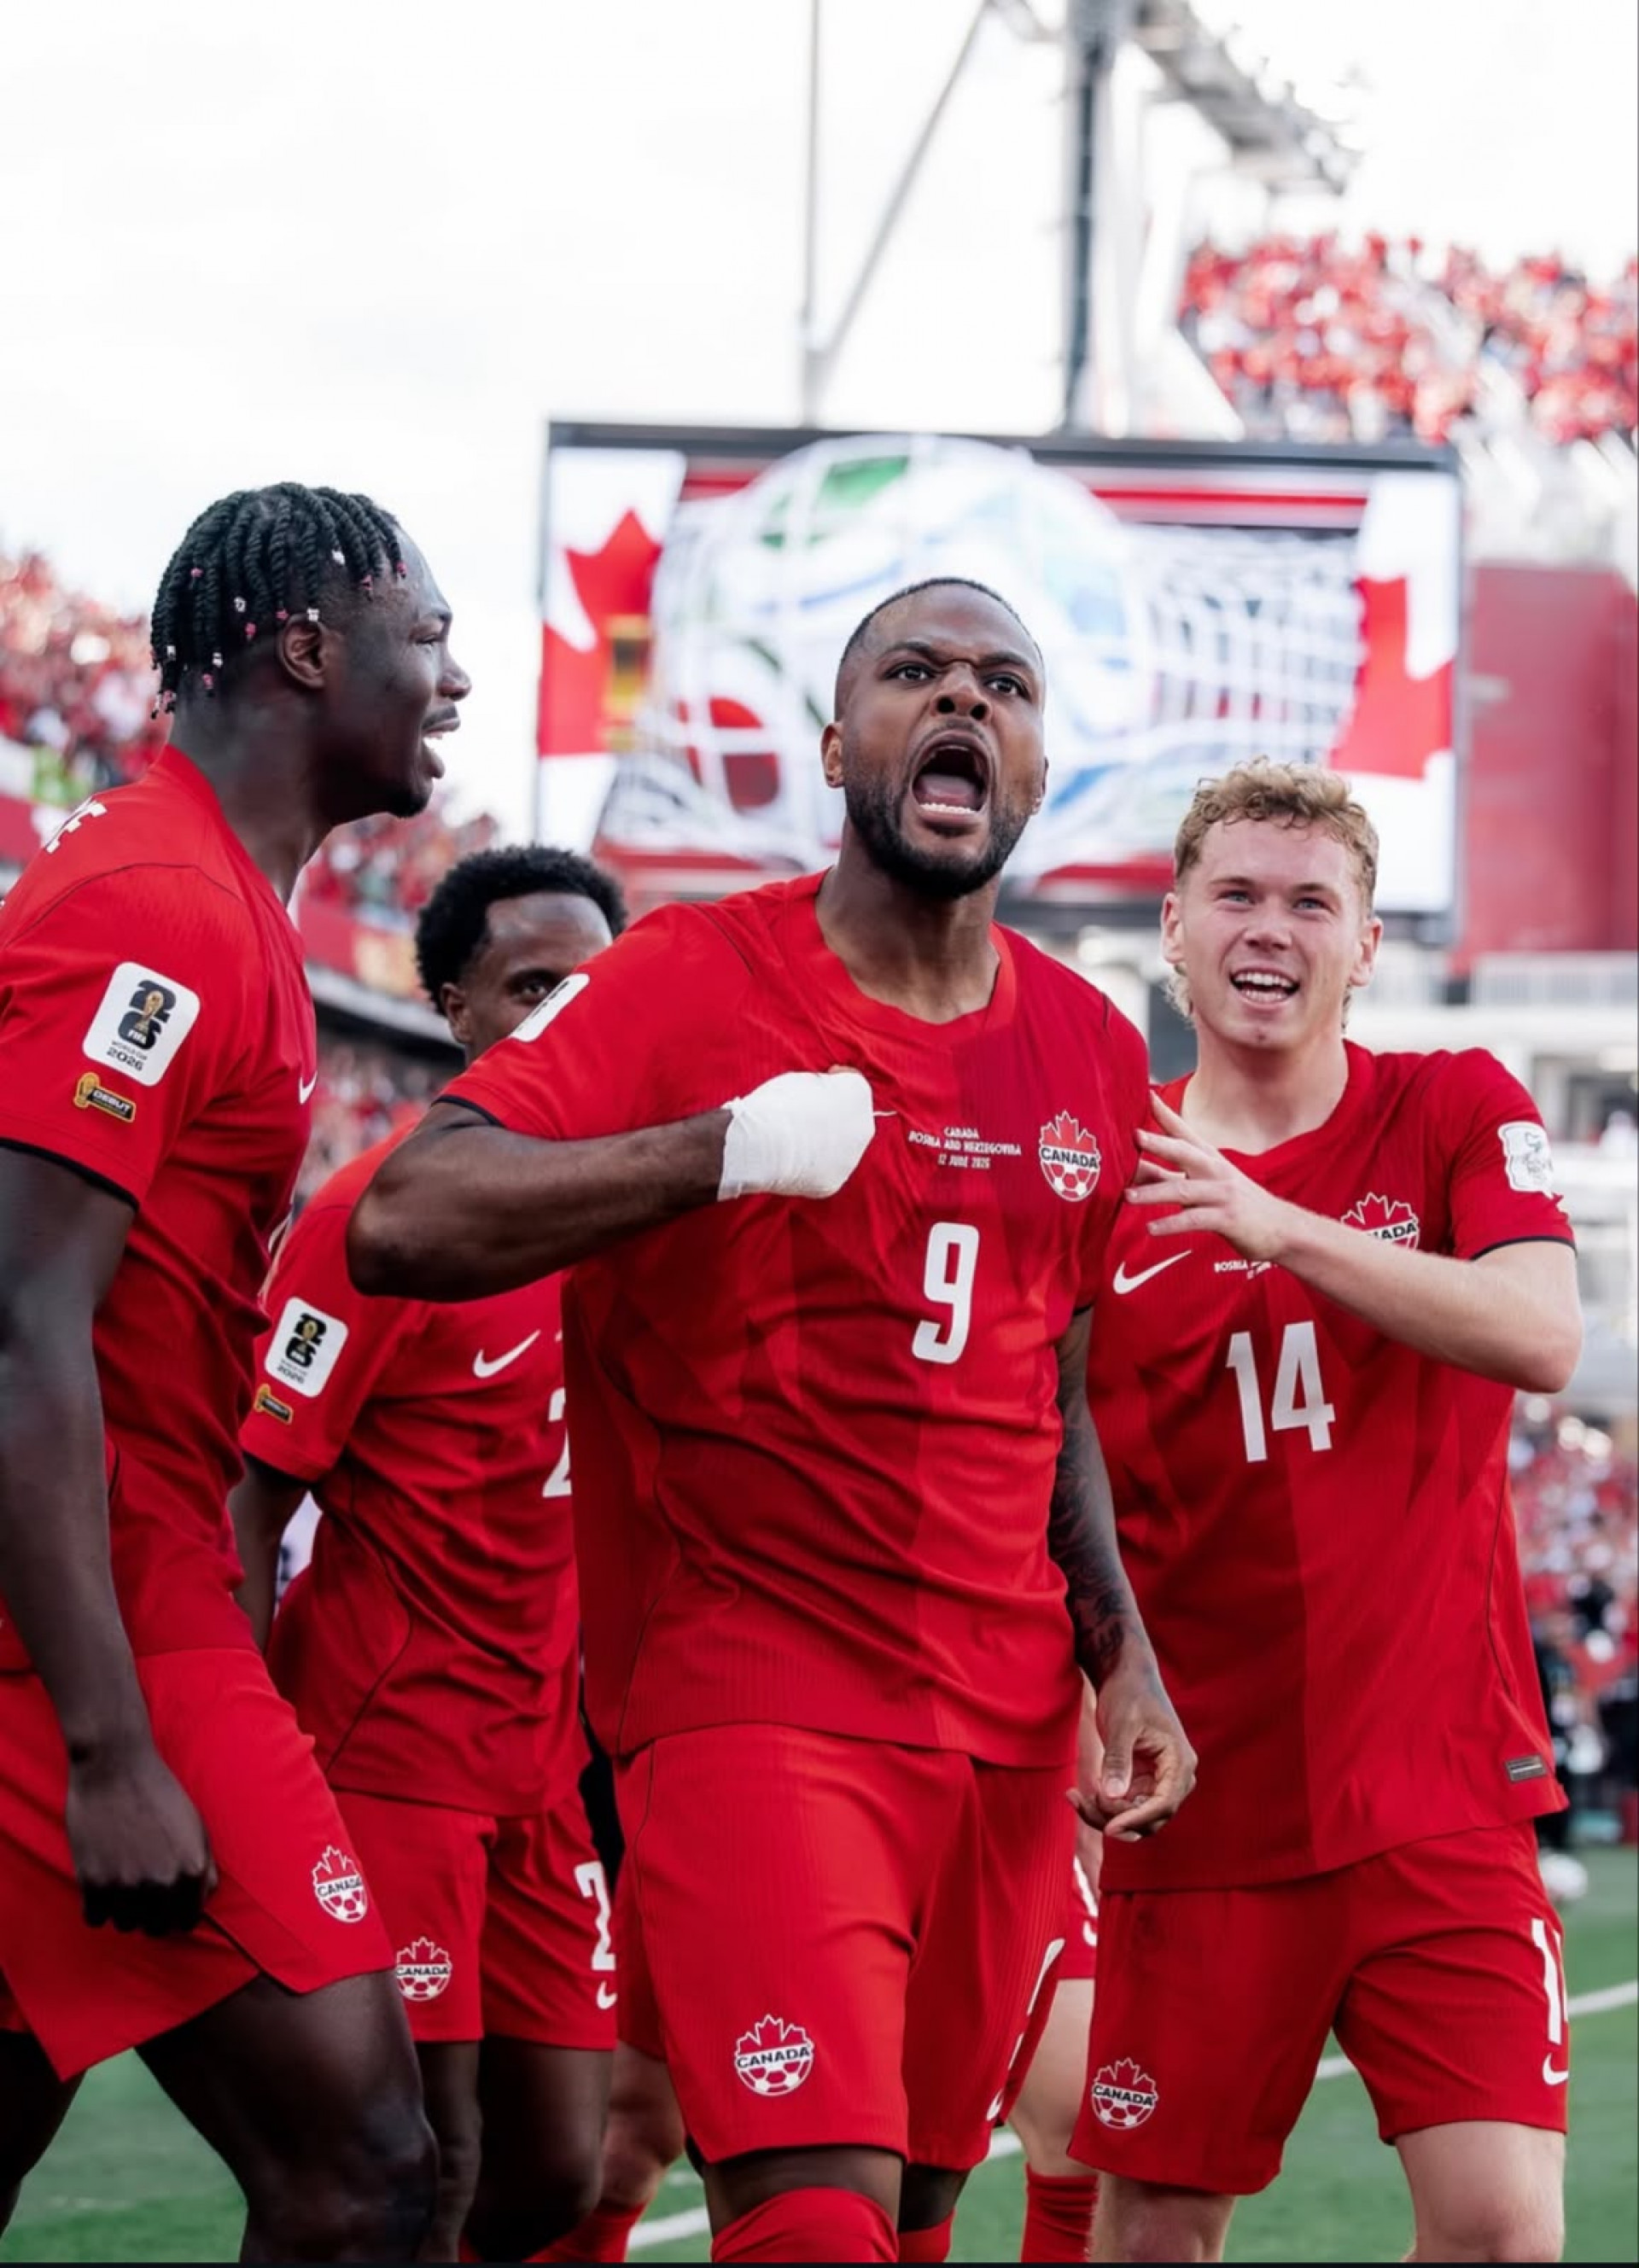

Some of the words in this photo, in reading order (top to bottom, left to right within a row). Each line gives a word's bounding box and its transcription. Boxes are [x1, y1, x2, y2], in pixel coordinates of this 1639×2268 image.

[106, 1047, 145, 1071] 2026
[92, 1088, 131, 1113] DEBUT
[943, 1126, 979, 1140] CANADA
[1041, 1146, 1099, 1169] CANADA
[912, 1221, 980, 1365] 9
[1226, 1320, 1336, 1463] 14
[317, 1877, 361, 1898] CANADA
[396, 1966, 449, 1976] CANADA
[737, 2047, 810, 2069] CANADA
[1094, 2084, 1153, 2106] CANADA
